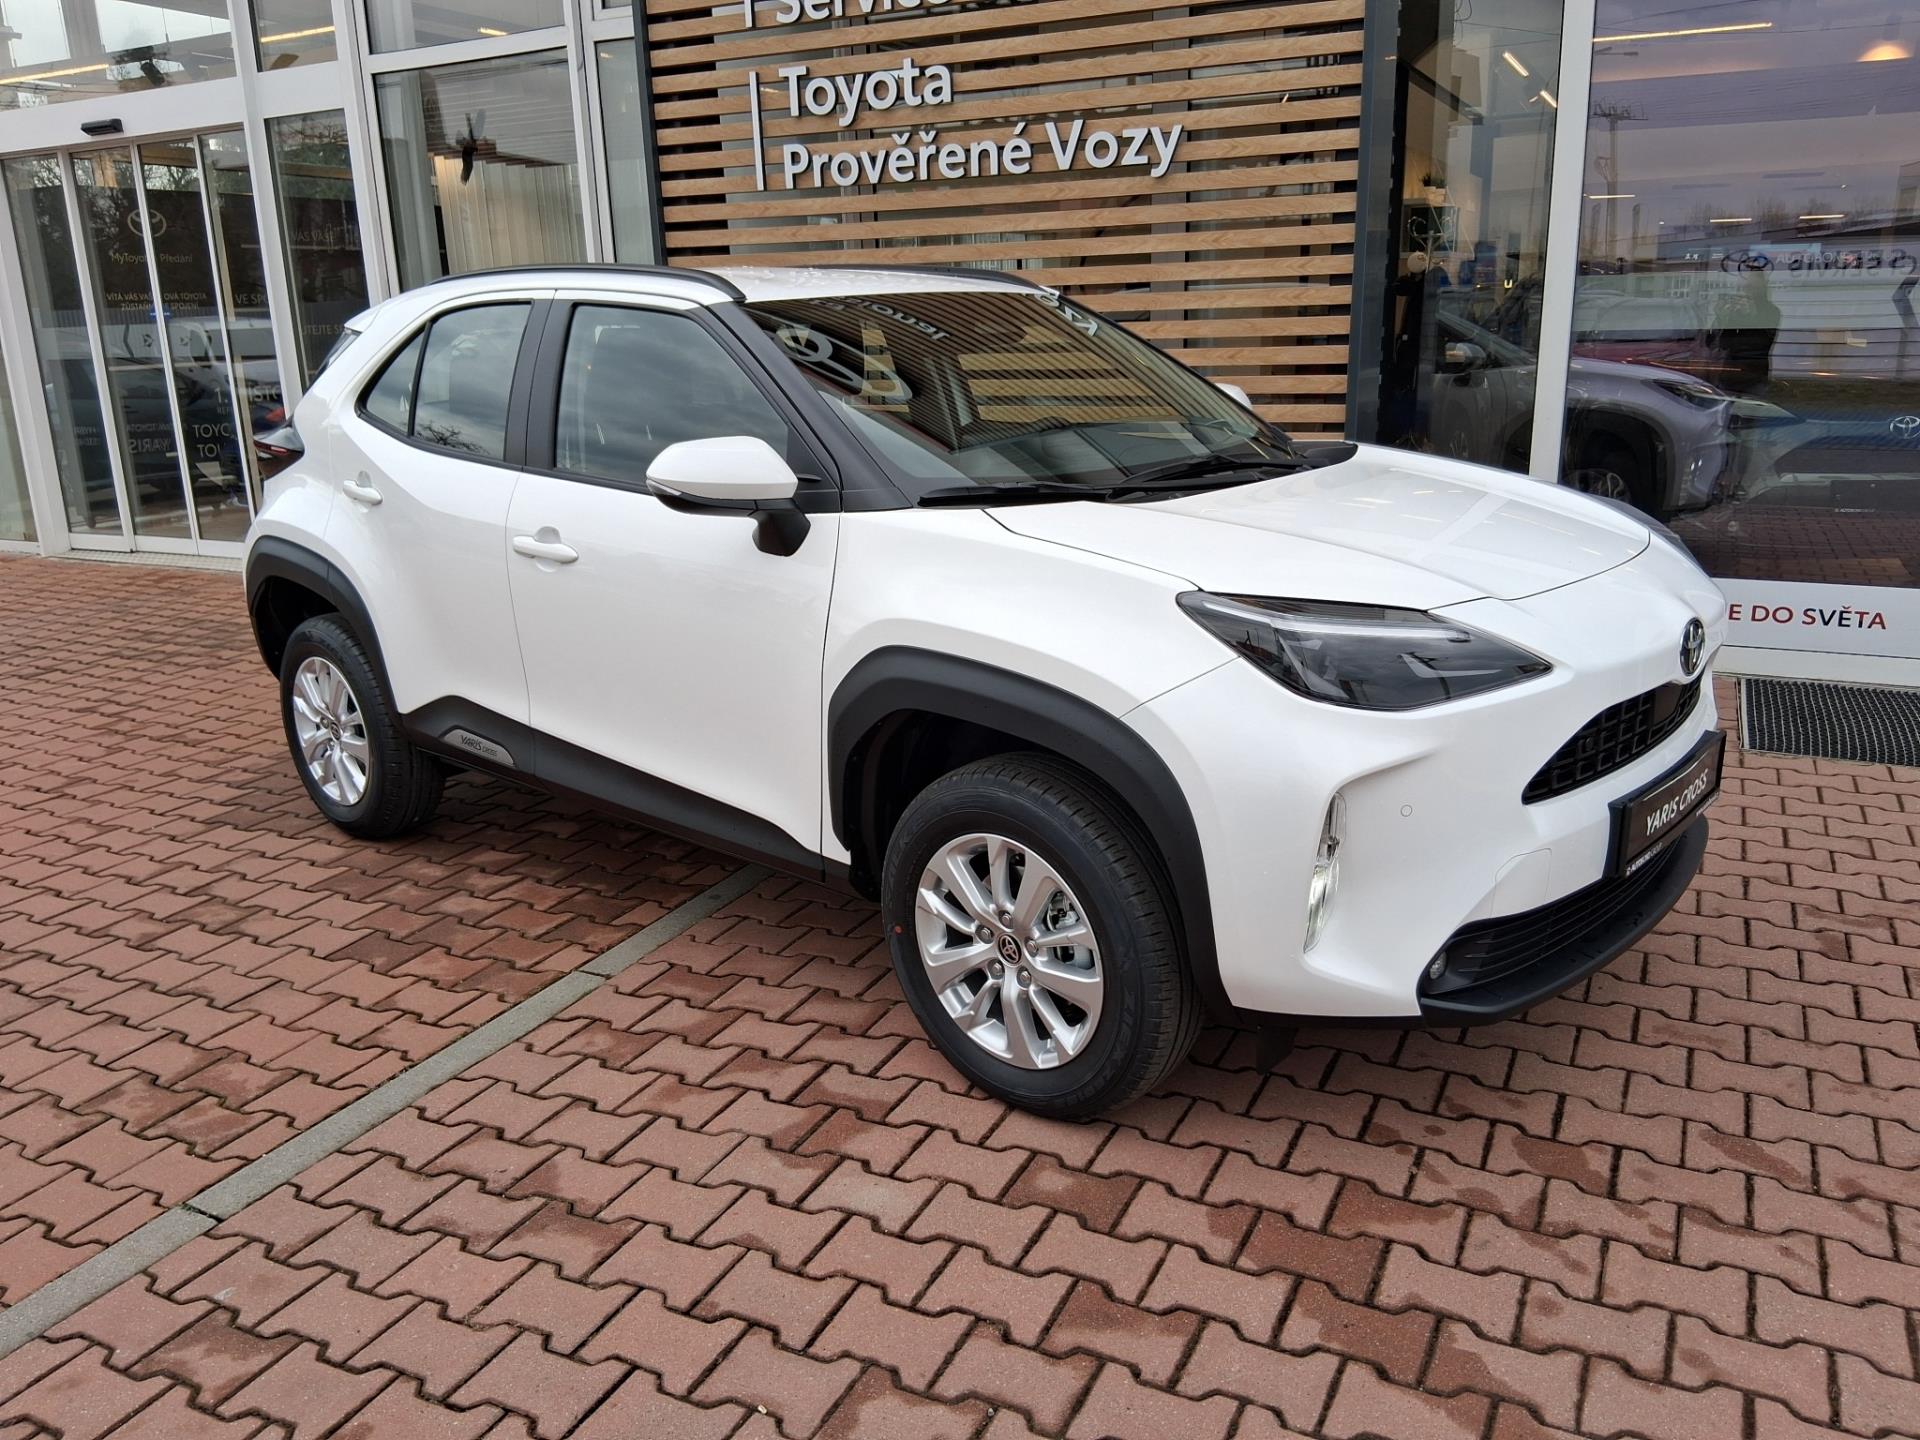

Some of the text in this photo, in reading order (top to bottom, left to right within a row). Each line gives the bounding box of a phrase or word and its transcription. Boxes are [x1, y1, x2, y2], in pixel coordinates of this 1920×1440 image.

[778, 57, 954, 127] Toyota
[783, 118, 1184, 191] Prověřené Vozy
[1751, 605, 1794, 625] DO
[1802, 605, 1887, 630] SVĚTA
[1646, 801, 1678, 836] YARIS
[1679, 768, 1709, 811] CROSS
